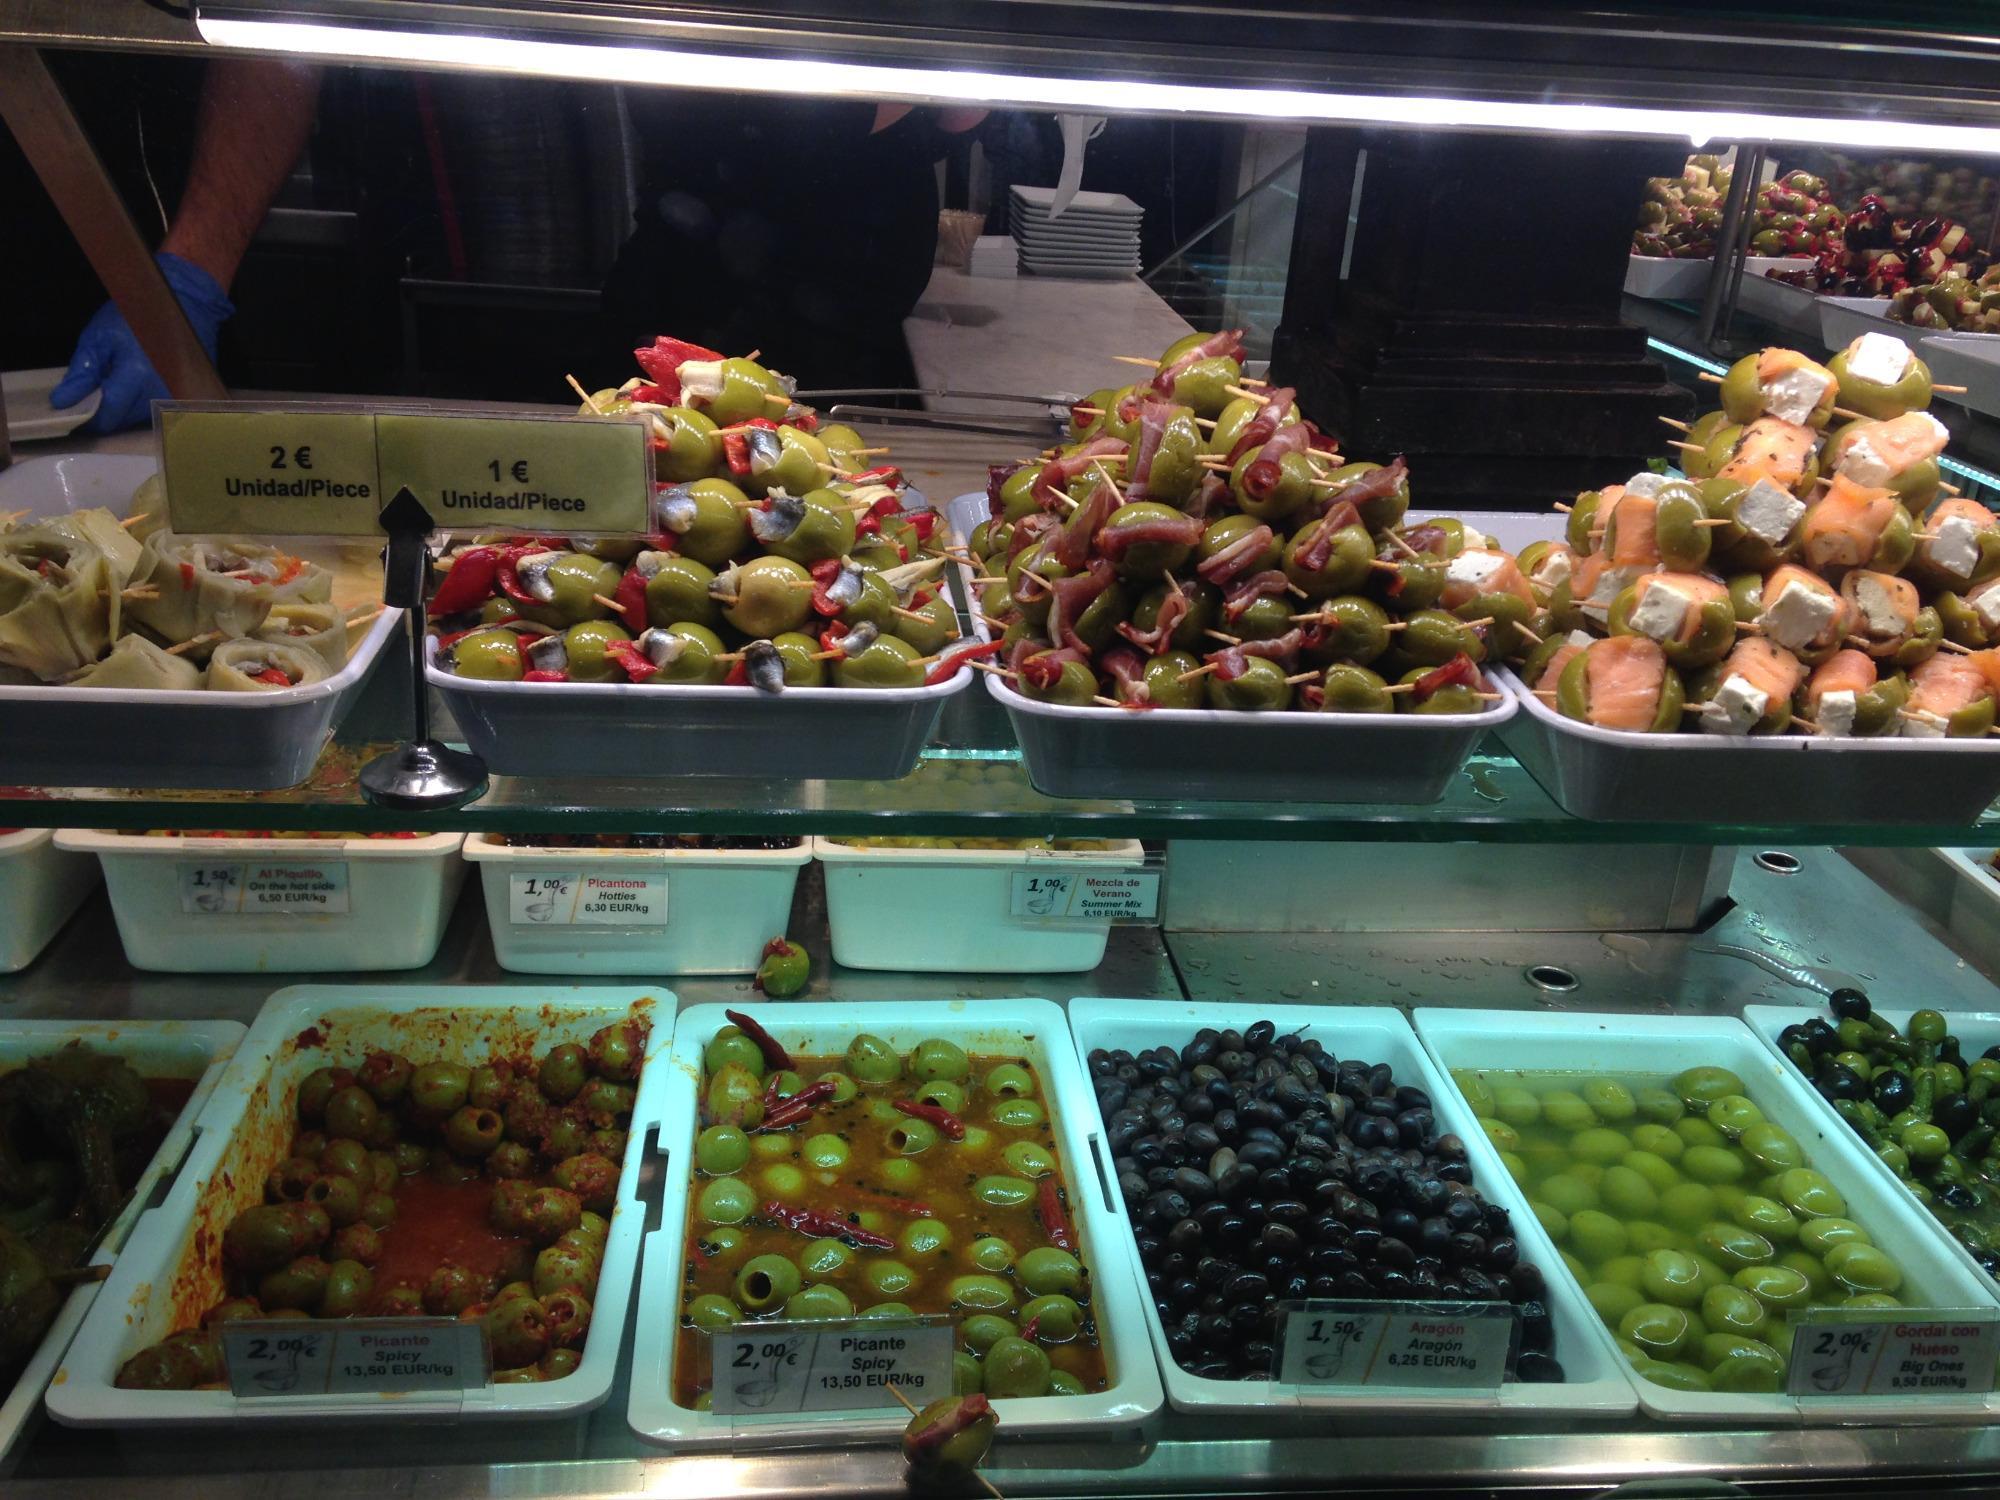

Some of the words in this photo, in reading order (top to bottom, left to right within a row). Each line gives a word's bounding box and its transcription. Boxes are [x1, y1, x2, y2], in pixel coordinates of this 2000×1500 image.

[270, 446, 287, 469] 2
[294, 446, 313, 470] €
[488, 460, 500, 482] 1
[511, 460, 529, 483] €
[225, 477, 371, 499] Unidad/Piece
[441, 490, 586, 512] Unidad/Piece
[276, 868, 323, 881] Piquillo
[249, 882, 265, 891] On
[269, 881, 286, 891] the
[290, 881, 308, 891] hot
[312, 881, 336, 891] side
[587, 878, 647, 889] Picantona
[1086, 878, 1124, 887] Mezcla
[1126, 878, 1140, 887] de
[258, 893, 282, 903] 6,50
[285, 892, 327, 904] EUR/kg
[598, 891, 637, 901] Hotties
[1093, 889, 1132, 898] Verano
[585, 903, 606, 913] 6,30
[610, 903, 649, 914] EUR/kg
[1081, 899, 1122, 909] Summer
[1125, 899, 1142, 909] Mix
[1084, 910, 1102, 918] 6,10
[1104, 910, 1137, 918] EUR/kg
[1409, 1321, 1465, 1338] Aragón
[1895, 1324, 1946, 1338] Gordal
[1951, 1327, 1980, 1338] con
[360, 1334, 431, 1348] Picante
[840, 1336, 906, 1352] Picante
[1407, 1337, 1463, 1352] Aragón
[1910, 1342, 1960, 1356] Hueso
[374, 1350, 422, 1364] Spicy
[851, 1357, 896, 1371] Spicy
[1388, 1353, 1418, 1367] 6,25
[1423, 1355, 1477, 1370] EUR/kg
[344, 1365, 388, 1378] 13,50
[392, 1363, 454, 1377] EUR/kg
[1900, 1360, 1924, 1374] Big
[1928, 1360, 1965, 1372] Ones
[820, 1375, 862, 1390] 13,50
[866, 1372, 925, 1388] EUR/kg
[1920, 1375, 1967, 1389] EUR/kg
